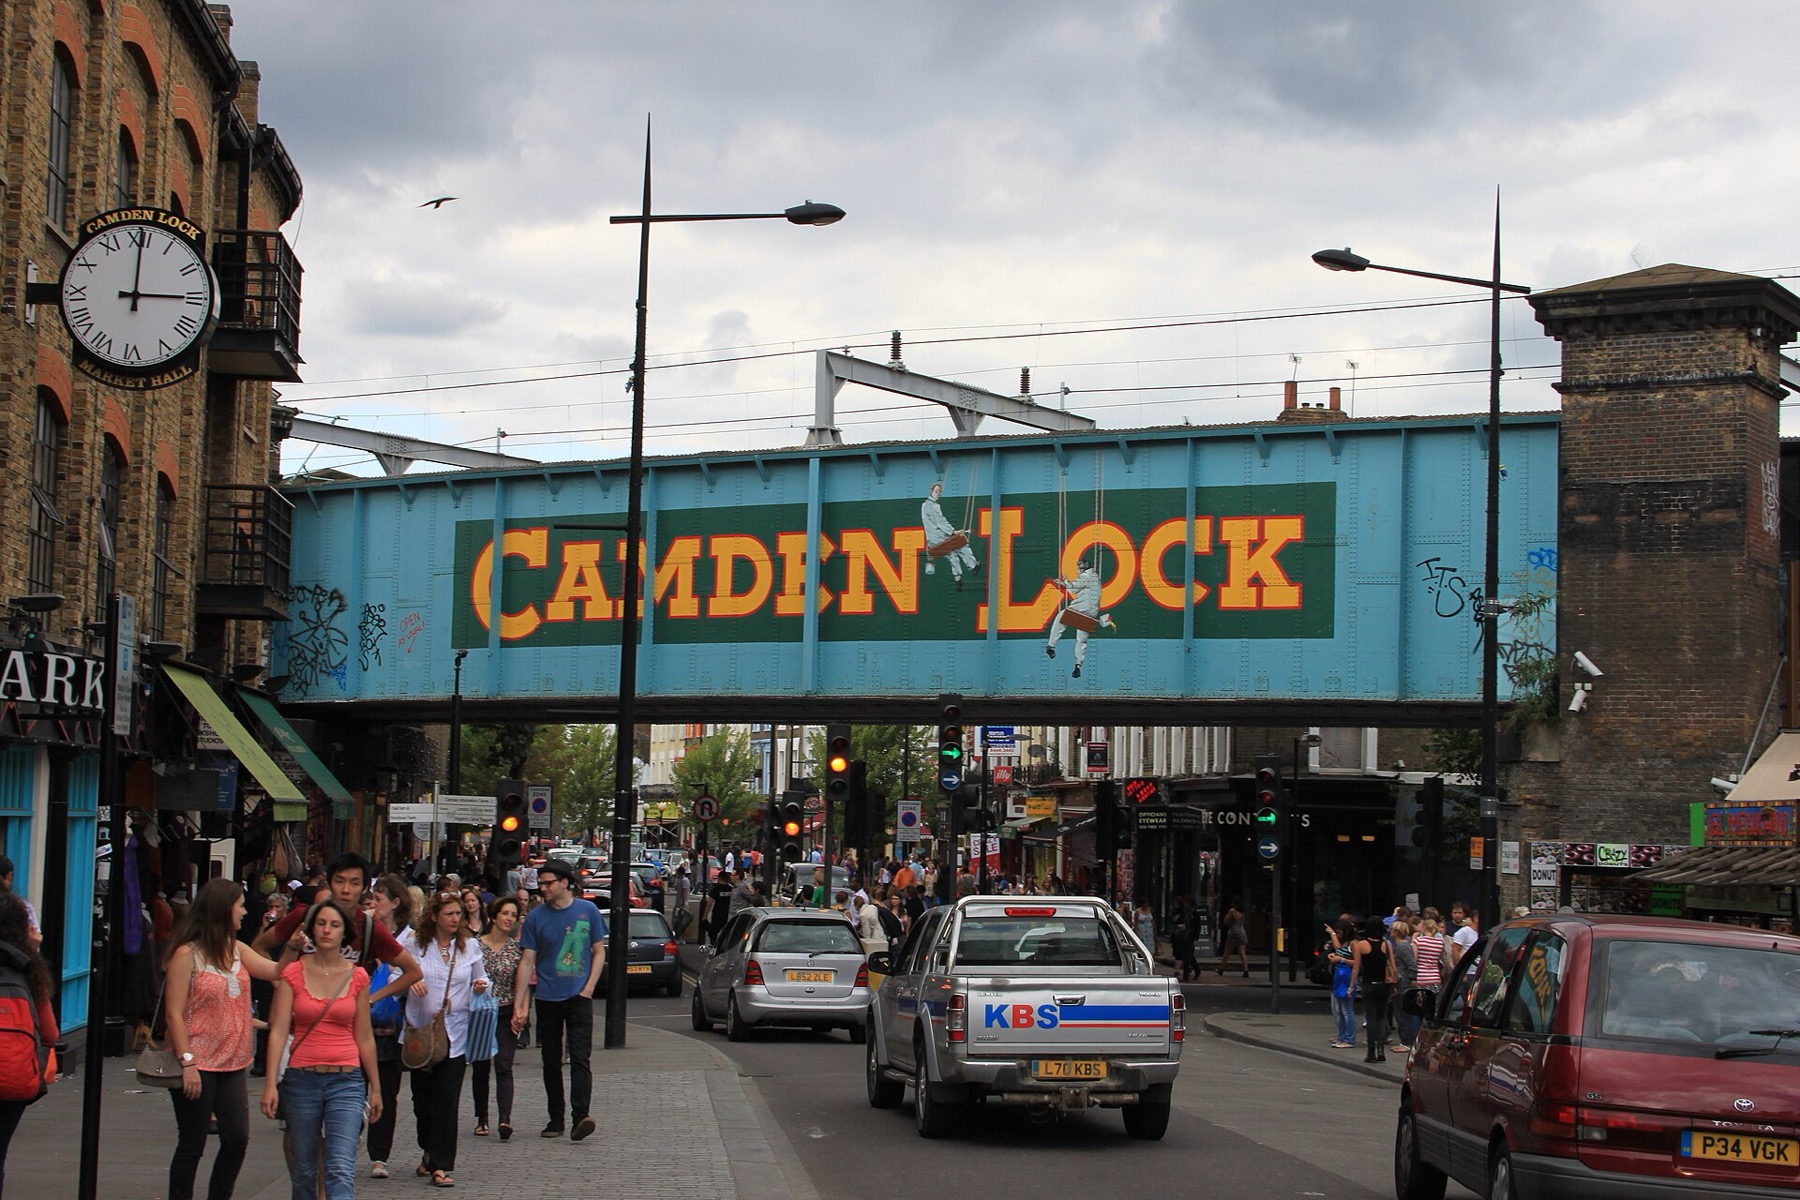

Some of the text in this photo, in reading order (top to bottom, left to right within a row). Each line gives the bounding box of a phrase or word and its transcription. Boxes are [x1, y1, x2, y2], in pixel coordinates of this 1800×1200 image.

[86, 209, 201, 240] CAMDEN LOCK
[79, 361, 192, 387] MARKET HALL
[471, 526, 925, 640] CAMDEN
[975, 506, 1305, 633] LOCK
[400, 612, 420, 632] OPEN
[0, 650, 105, 709] ARK
[995, 769, 1011, 781] illy
[973, 843, 998, 856] SLE
[984, 1003, 1058, 1030] KBS
[1045, 1062, 1101, 1076] L70 KBS
[1586, 1092, 1604, 1100] GS
[1702, 1135, 1790, 1162] P34 VGK
